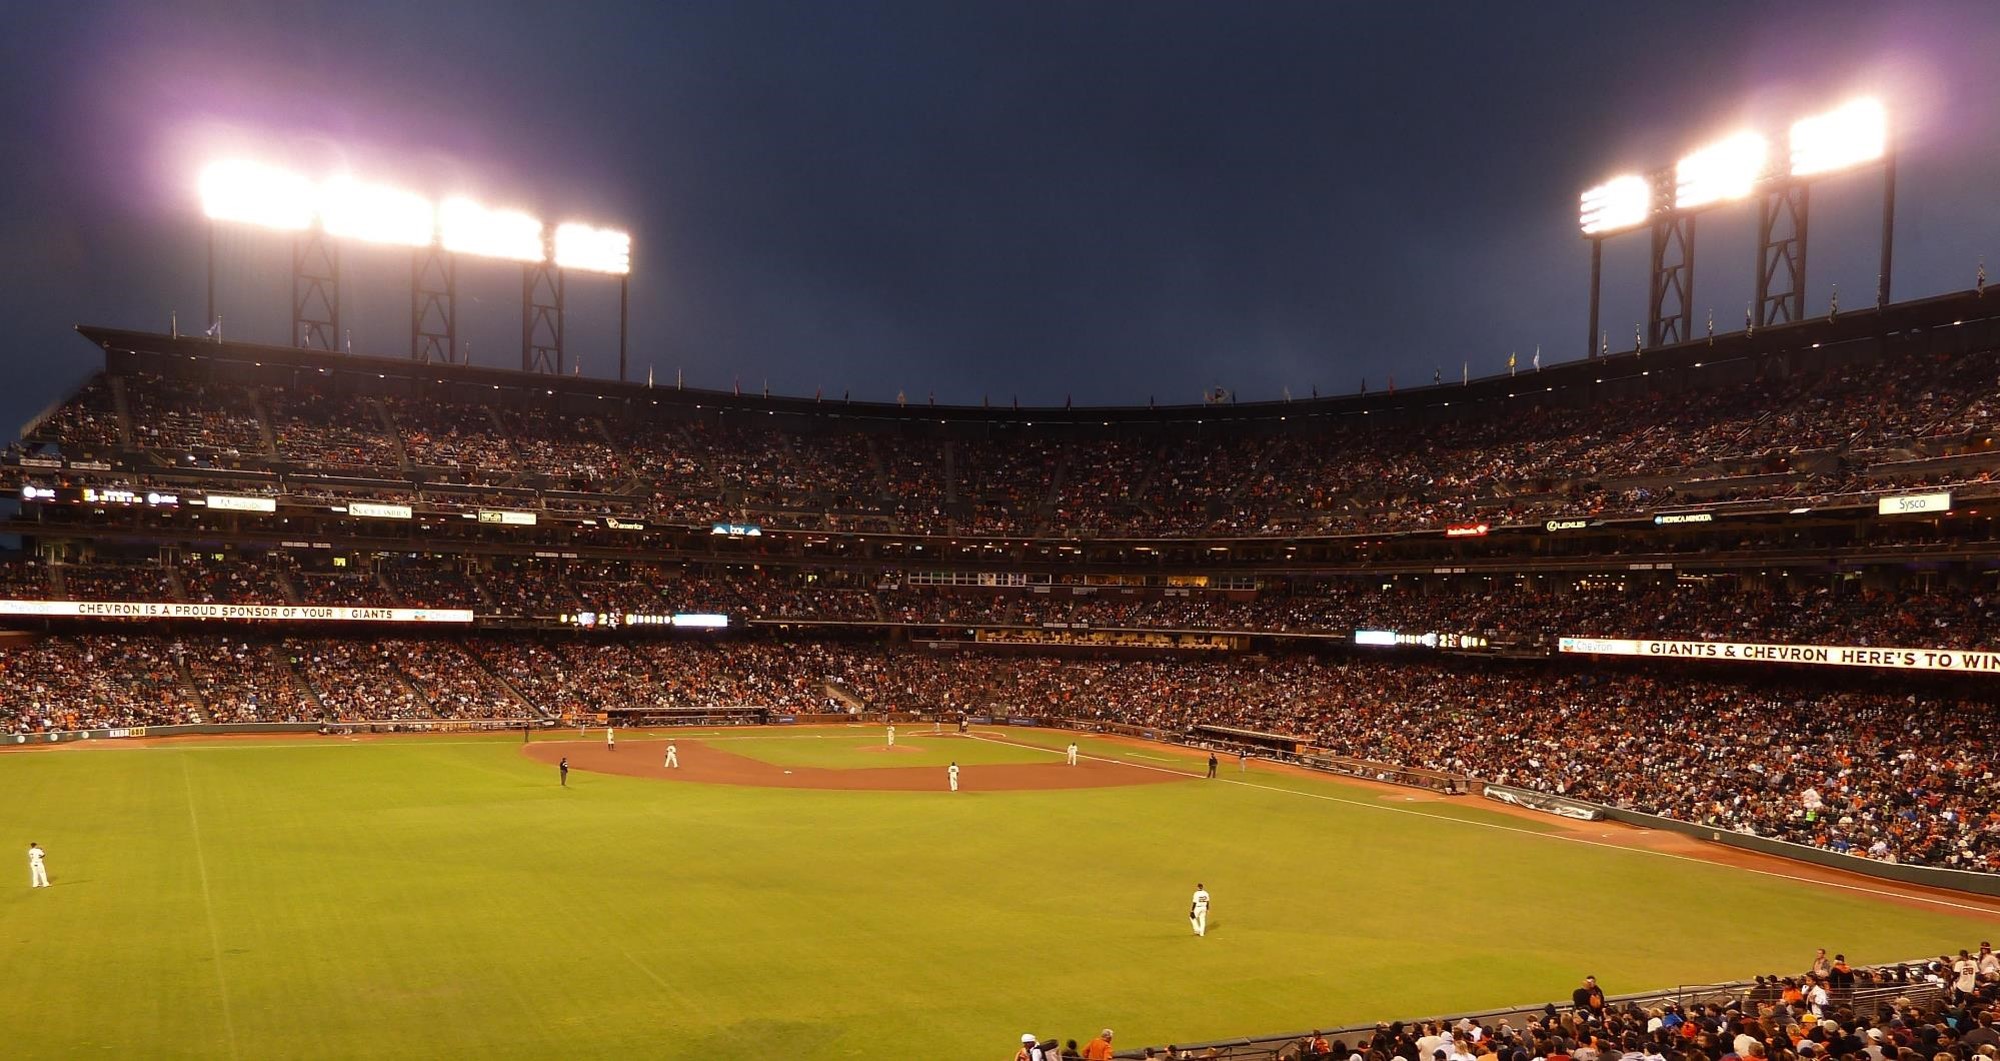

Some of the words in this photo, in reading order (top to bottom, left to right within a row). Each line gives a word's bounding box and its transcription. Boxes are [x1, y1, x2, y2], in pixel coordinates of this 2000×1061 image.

[1899, 498, 1926, 511] Sysco
[729, 524, 745, 535] box
[1557, 520, 1586, 530] LEXUS
[78, 603, 140, 614] CHEVRON
[145, 604, 156, 615] IS
[162, 605, 170, 615] A
[175, 605, 217, 616] PROUD
[222, 606, 277, 617] SPONSOR
[282, 607, 296, 618] OF
[302, 608, 333, 618] YOUR
[351, 609, 393, 619] GIANTS
[1576, 641, 1613, 652] Chevron
[1650, 643, 1717, 656] GIANTS
[1724, 645, 1736, 657] &
[1743, 646, 1828, 661] CHEVRON
[1842, 650, 1916, 666] HERE'S
[1925, 653, 1952, 667] TO
[1962, 654, 2000, 669] WIN
